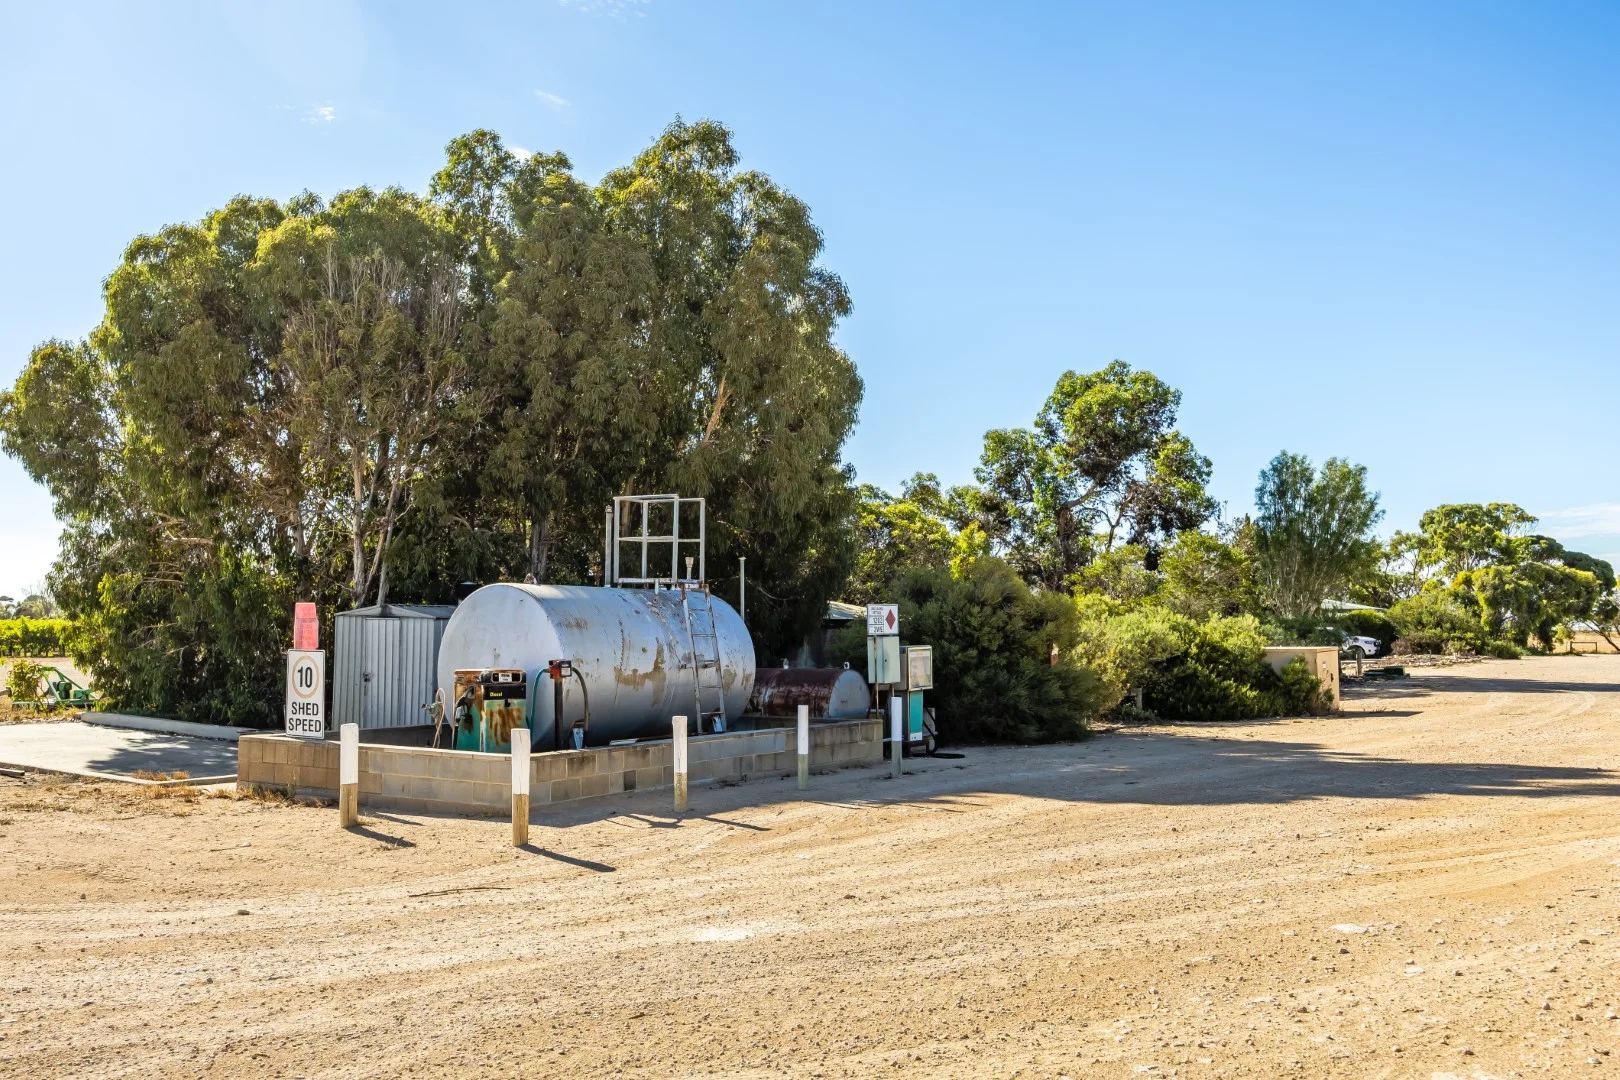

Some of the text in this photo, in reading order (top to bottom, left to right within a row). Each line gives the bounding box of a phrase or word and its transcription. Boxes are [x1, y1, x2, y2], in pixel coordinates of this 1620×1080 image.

[297, 666, 313, 688] 10
[291, 701, 319, 716] SHED
[288, 717, 322, 733] SPEED
